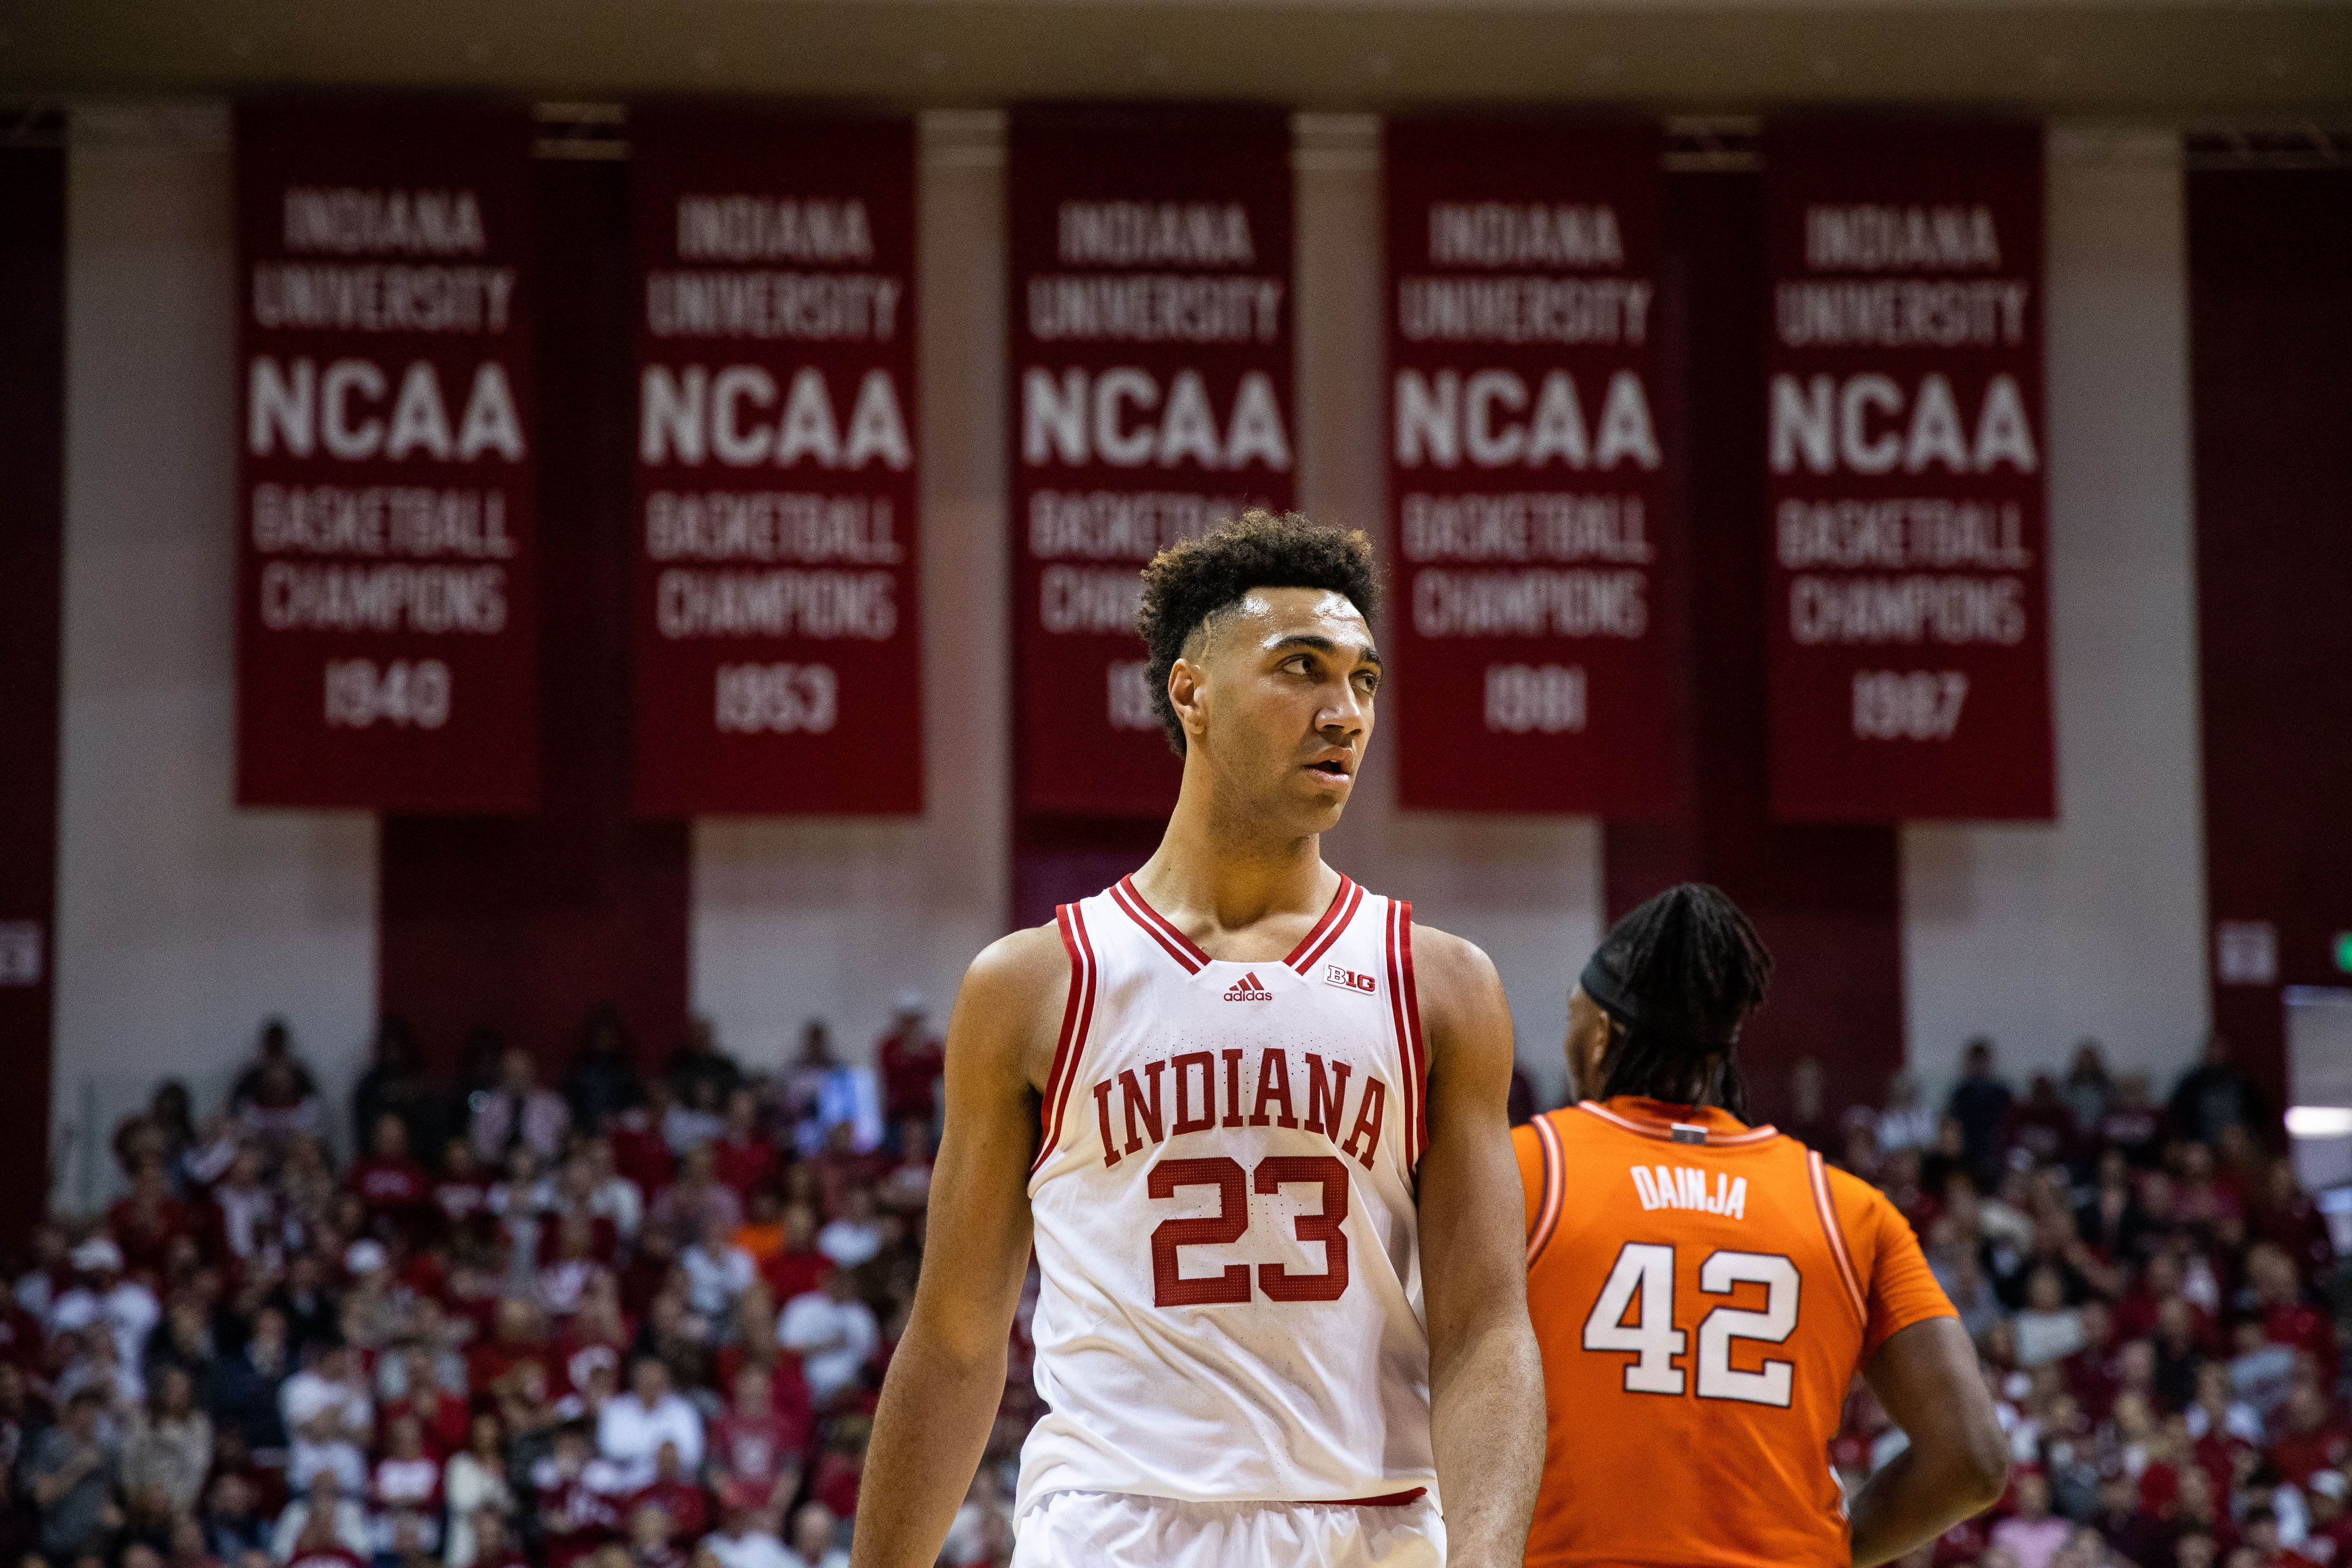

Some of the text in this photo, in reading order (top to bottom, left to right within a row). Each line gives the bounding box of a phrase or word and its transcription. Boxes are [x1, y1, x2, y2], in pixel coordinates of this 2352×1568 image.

[285, 189, 484, 252] INDIANA
[678, 196, 872, 261] INDIANA
[1060, 202, 1252, 264] INDIANA
[1430, 203, 1622, 266] INDIANA
[1807, 206, 1999, 269] INDIANA
[254, 265, 513, 330] UNIVERSITY
[648, 272, 899, 339] UNIVERSITY
[1029, 275, 1281, 341] UNIVERSITY
[1400, 278, 1650, 342] UNIVERSITY
[1778, 281, 2026, 345] UNIVERSITY
[249, 359, 523, 460] NCAA
[641, 367, 911, 468] NCAA
[1023, 369, 1289, 468] NCAA
[1395, 371, 1659, 468] NCAA
[1770, 375, 2037, 473] NCAA
[253, 484, 514, 556] BASKETBALL
[647, 492, 900, 563] BASKETBALL
[1403, 494, 1650, 562] BASKETBALL
[1778, 499, 2028, 568] BASKETBALL
[261, 561, 507, 633] CHAMPIONS
[658, 570, 895, 639] CHAMPIONS
[1414, 570, 1645, 636] CHAMPIONS
[1791, 576, 2024, 643] CHAMPIONS
[1223, 990, 1272, 1002] adidas
[1094, 1048, 1386, 1169] INDIANA
[1630, 1165, 1747, 1220] DAINJA
[1147, 1156, 1349, 1307] 23
[1582, 1241, 1800, 1409] 42
